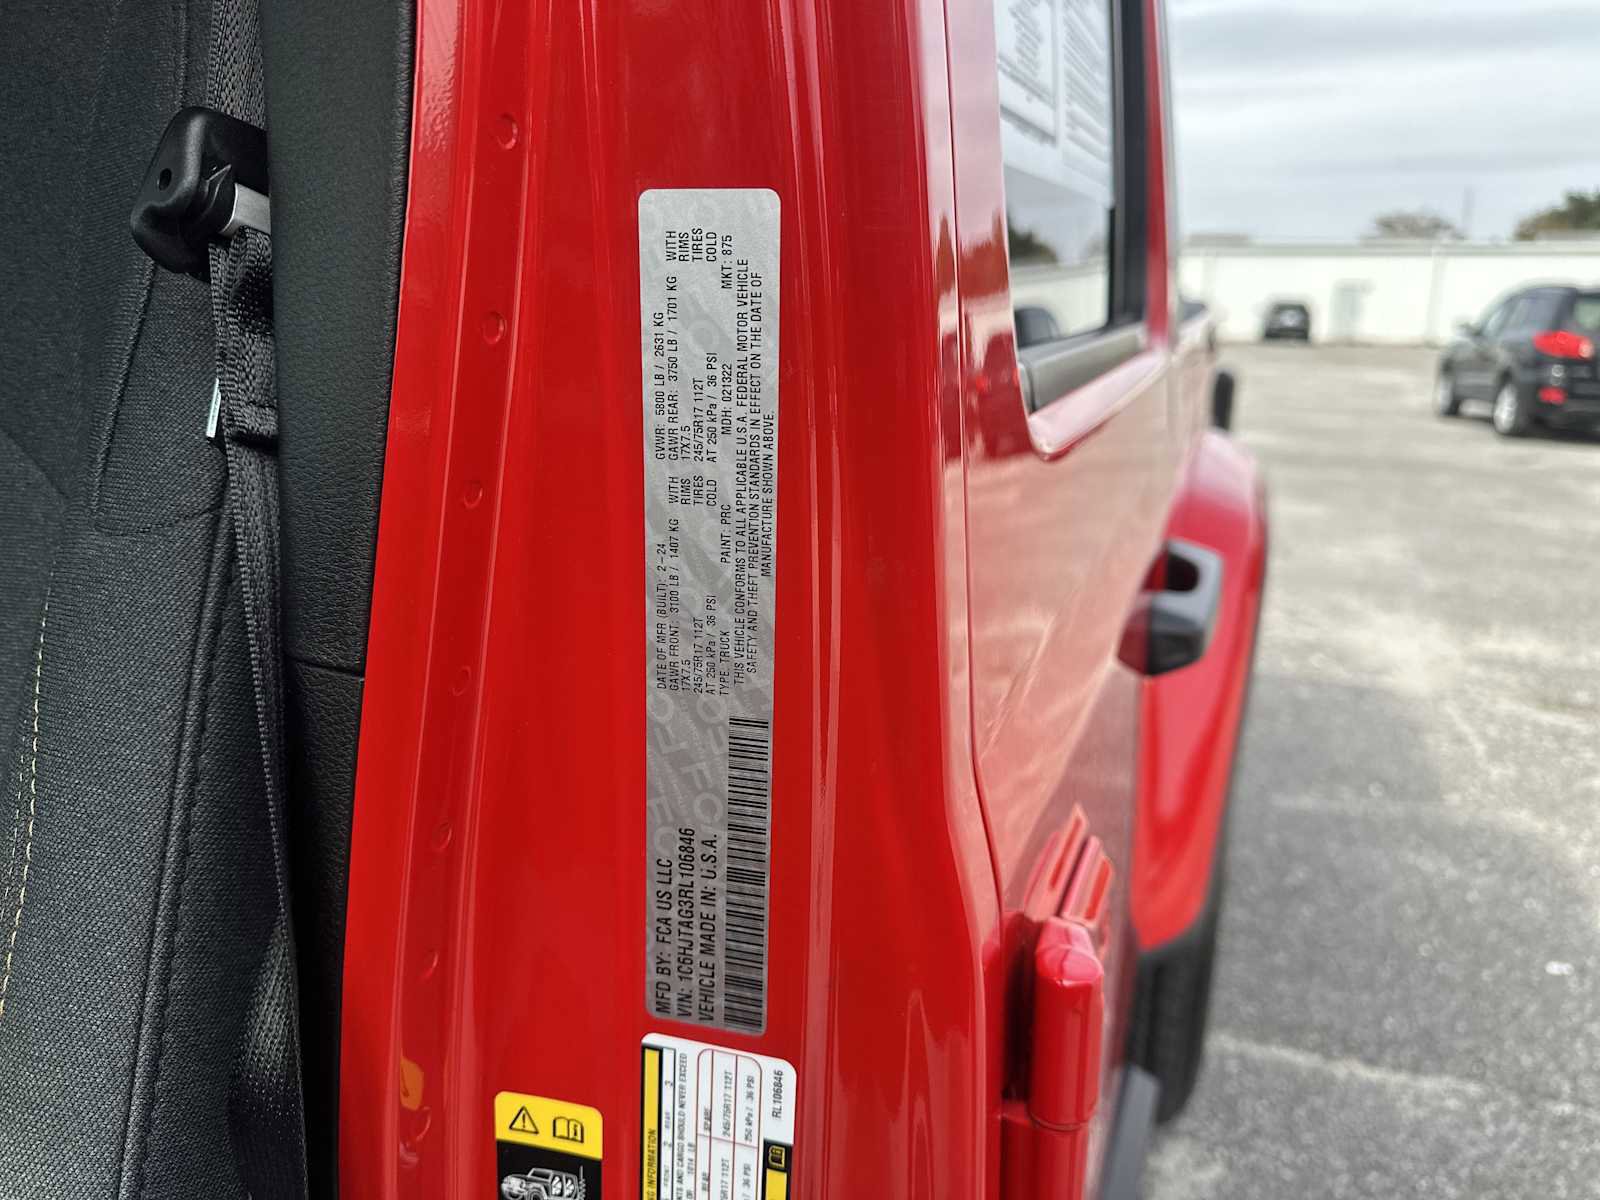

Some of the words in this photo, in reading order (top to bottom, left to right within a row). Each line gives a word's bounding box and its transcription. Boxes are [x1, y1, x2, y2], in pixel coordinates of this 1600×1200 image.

[666, 231, 677, 261] WITH
[679, 232, 689, 261] RIMS
[692, 228, 703, 262] TIRES
[706, 232, 717, 262] COLD
[722, 235, 732, 256] 875
[667, 276, 677, 291] KG
[722, 261, 732, 289] MKT:
[737, 259, 748, 306] VEHICLE
[751, 272, 762, 287] OF
[654, 312, 664, 326] KG
[667, 297, 677, 321] 1701
[751, 291, 761, 322] DATE
[654, 332, 664, 357] 2631
[667, 339, 677, 352] LB
[737, 312, 748, 352] MOTOR
[751, 327, 761, 348] THE
[668, 356, 678, 381] 3750
[707, 352, 717, 369] PSI
[750, 353, 761, 368] ON
[655, 374, 664, 386] LB
[693, 377, 703, 402] 112T
[707, 375, 717, 387] 36
[722, 363, 732, 402] 021322
[737, 357, 748, 406] FEDERAL
[750, 374, 761, 413] EFFECT
[655, 391, 664, 416] 5800
[668, 390, 678, 423] REAR:
[707, 404, 717, 422] kPa
[694, 407, 703, 462] 245/75R17
[721, 407, 731, 435] MDH:
[736, 412, 747, 444] U.S.A.
[750, 419, 760, 429] IN
[763, 411, 774, 449] ABOVE.
[655, 424, 665, 460] GVWR:
[668, 428, 678, 460] GAWR
[681, 426, 691, 460] 17X7.5
[707, 427, 717, 444] 250
[707, 449, 717, 462] AT
[749, 434, 760, 500] STANDARDS
[736, 449, 747, 513] APPLICABLE
[763, 454, 773, 494] SHOWN
[669, 476, 678, 504] WITH
[681, 478, 691, 504] RIMS
[693, 475, 703, 505] TIRES
[707, 480, 717, 506] COLD
[669, 519, 679, 532] KG
[721, 504, 731, 525] PRC
[736, 518, 746, 536] ALL
[669, 536, 679, 558] 1407
[721, 530, 730, 563] PAINT:
[736, 541, 745, 553] TO
[748, 503, 759, 568] PREVENTION
[760, 498, 772, 576] MANUFACTURE
[670, 575, 679, 586] LB
[735, 558, 745, 613] CONFORMS
[748, 574, 758, 606] THEFT
[670, 591, 679, 613] 3100
[706, 595, 716, 610] PSI
[657, 623, 666, 644] MFR
[693, 617, 703, 639] 112T
[706, 615, 716, 626] 36
[747, 610, 757, 631] AND
[670, 621, 679, 656] FRONT:
[706, 641, 716, 658] kPa
[720, 630, 730, 663] TRUCK
[734, 619, 744, 658] VEHICLE
[657, 648, 666, 660] OF
[747, 635, 757, 673] SAFETY
[657, 664, 666, 689] DATE
[670, 661, 679, 691] GAWR
[682, 659, 691, 691] 17X7.5
[694, 644, 703, 694] 245/75R17
[706, 662, 716, 678] 250
[734, 663, 744, 685] THIS
[706, 682, 715, 694] AT
[701, 833, 717, 880] U.S.A.
[657, 858, 672, 885] LLC
[657, 890, 672, 910] US
[678, 828, 695, 982] 1C6HJTAG3RL106846
[700, 886, 716, 907] IN:
[657, 917, 672, 944] FCA
[700, 912, 716, 956] MADE
[656, 952, 671, 976] BY:
[656, 982, 671, 1014] MFD
[678, 989, 693, 1017] VIN:
[699, 962, 715, 1021] VEHICLE
[772, 1070, 783, 1118] RL106846
[647, 1128, 656, 1188] INFORMATION
